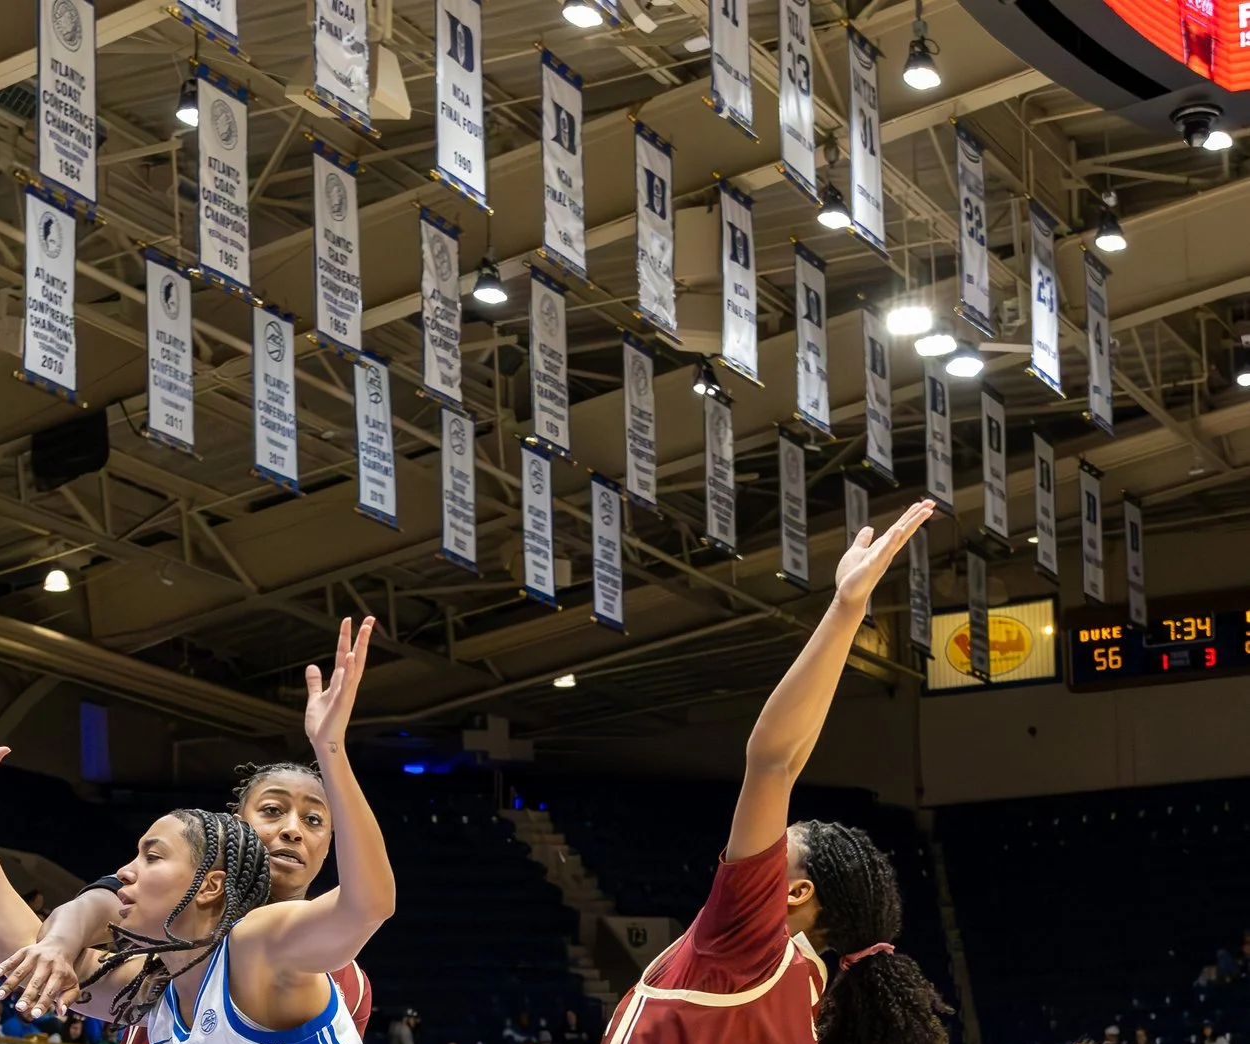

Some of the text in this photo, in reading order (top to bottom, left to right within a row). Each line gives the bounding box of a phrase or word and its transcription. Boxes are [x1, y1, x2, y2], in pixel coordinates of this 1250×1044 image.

[1079, 626, 1122, 643] DUKE
[1162, 617, 1211, 641] 7:34
[1094, 646, 1122, 671] 56
